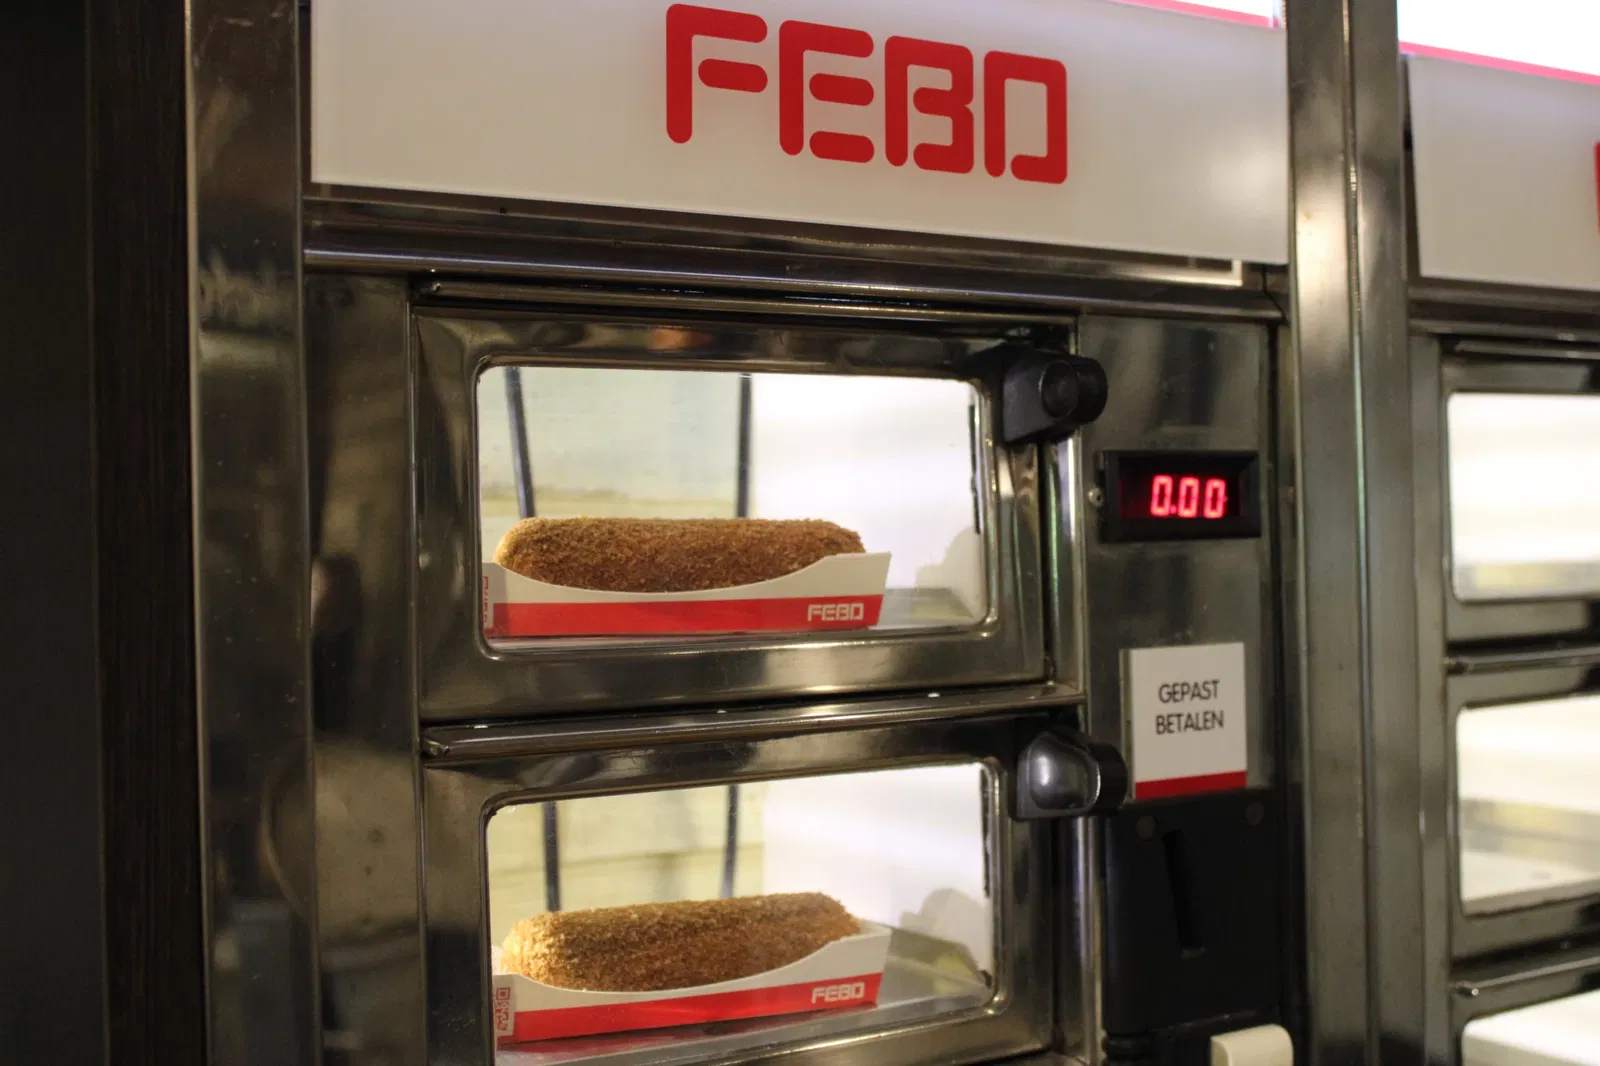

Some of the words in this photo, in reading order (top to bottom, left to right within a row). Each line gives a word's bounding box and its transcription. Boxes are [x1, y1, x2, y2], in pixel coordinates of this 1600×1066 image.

[666, 3, 1067, 184] FEBO
[1150, 474, 1227, 519] 0.00
[807, 602, 864, 621] FEBO
[1158, 679, 1220, 704] GEPAST
[1155, 710, 1225, 735] BETALEN
[811, 981, 865, 1004] FEBO
